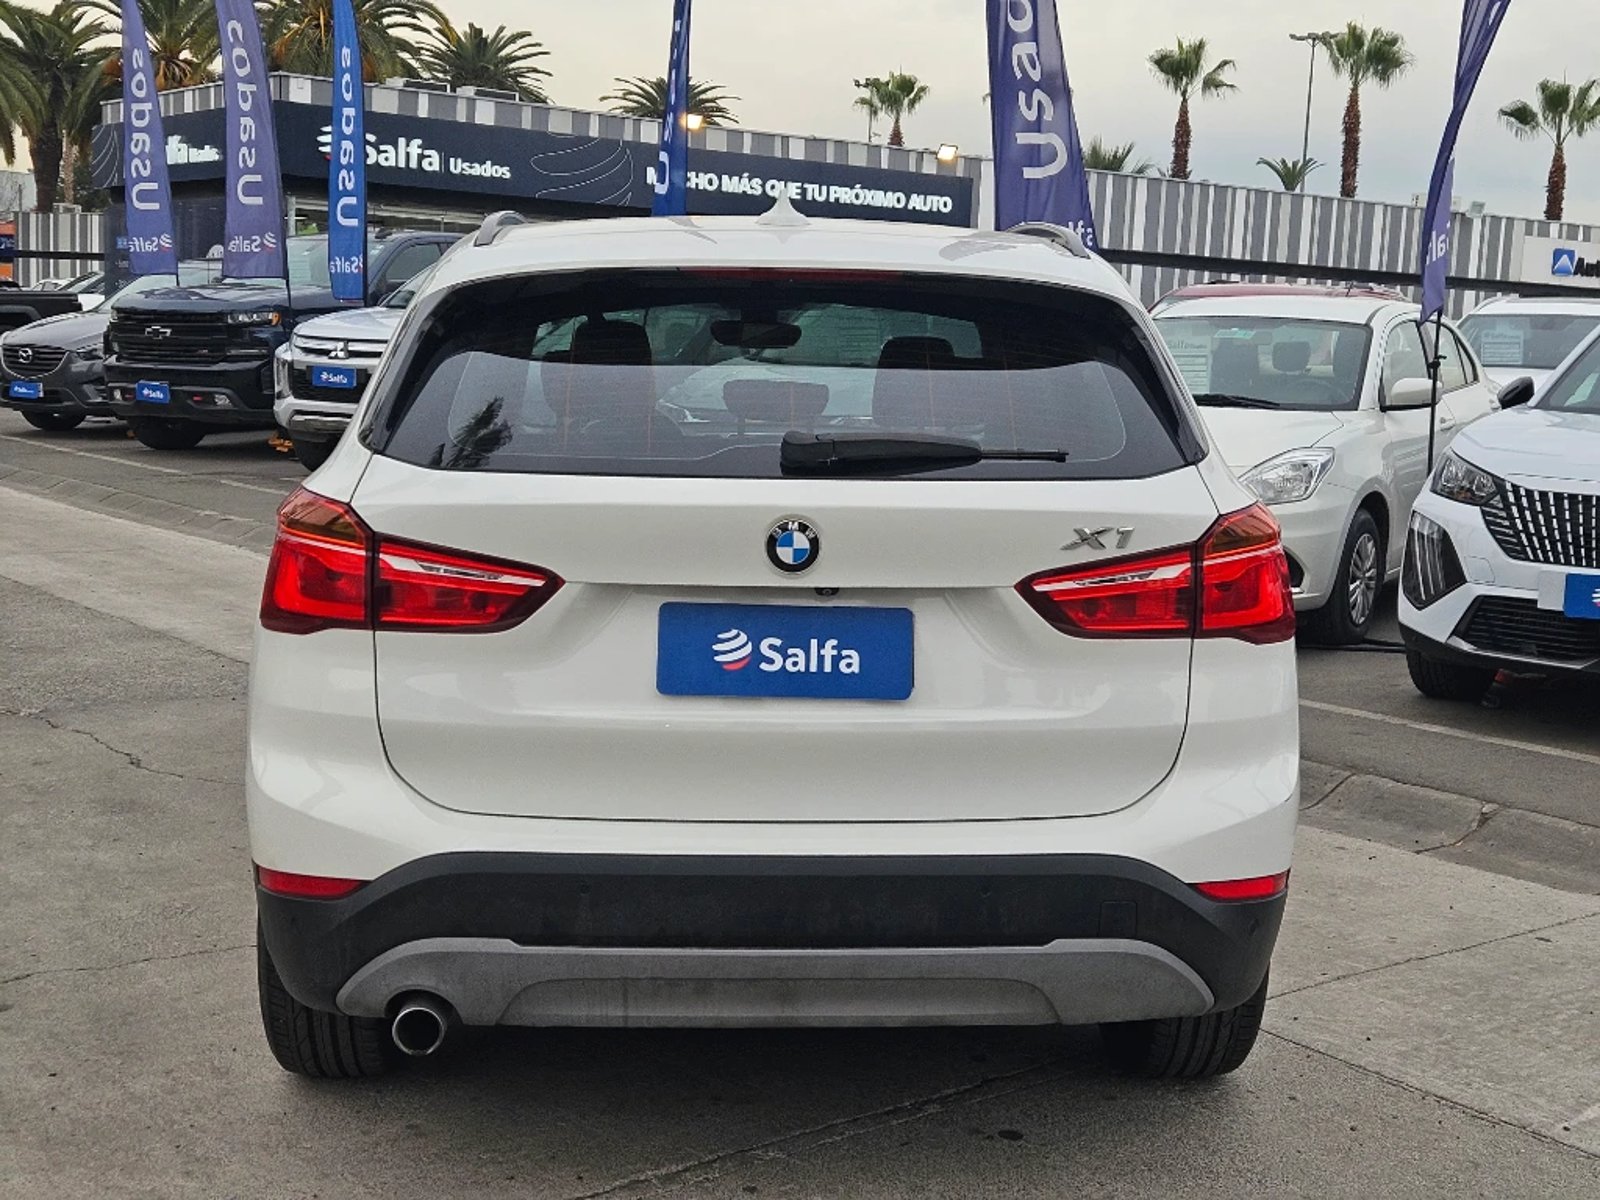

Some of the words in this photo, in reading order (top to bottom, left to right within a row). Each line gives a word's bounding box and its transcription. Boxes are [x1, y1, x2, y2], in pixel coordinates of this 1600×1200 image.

[449, 157, 512, 179] Usados
[721, 172, 763, 196] MÁS
[803, 183, 828, 202] TU
[829, 184, 907, 209] PRÓXIMO
[907, 193, 953, 213] AUTO
[770, 520, 818, 539] BMW
[1058, 525, 1137, 552] X1
[758, 637, 861, 675] Salfa
